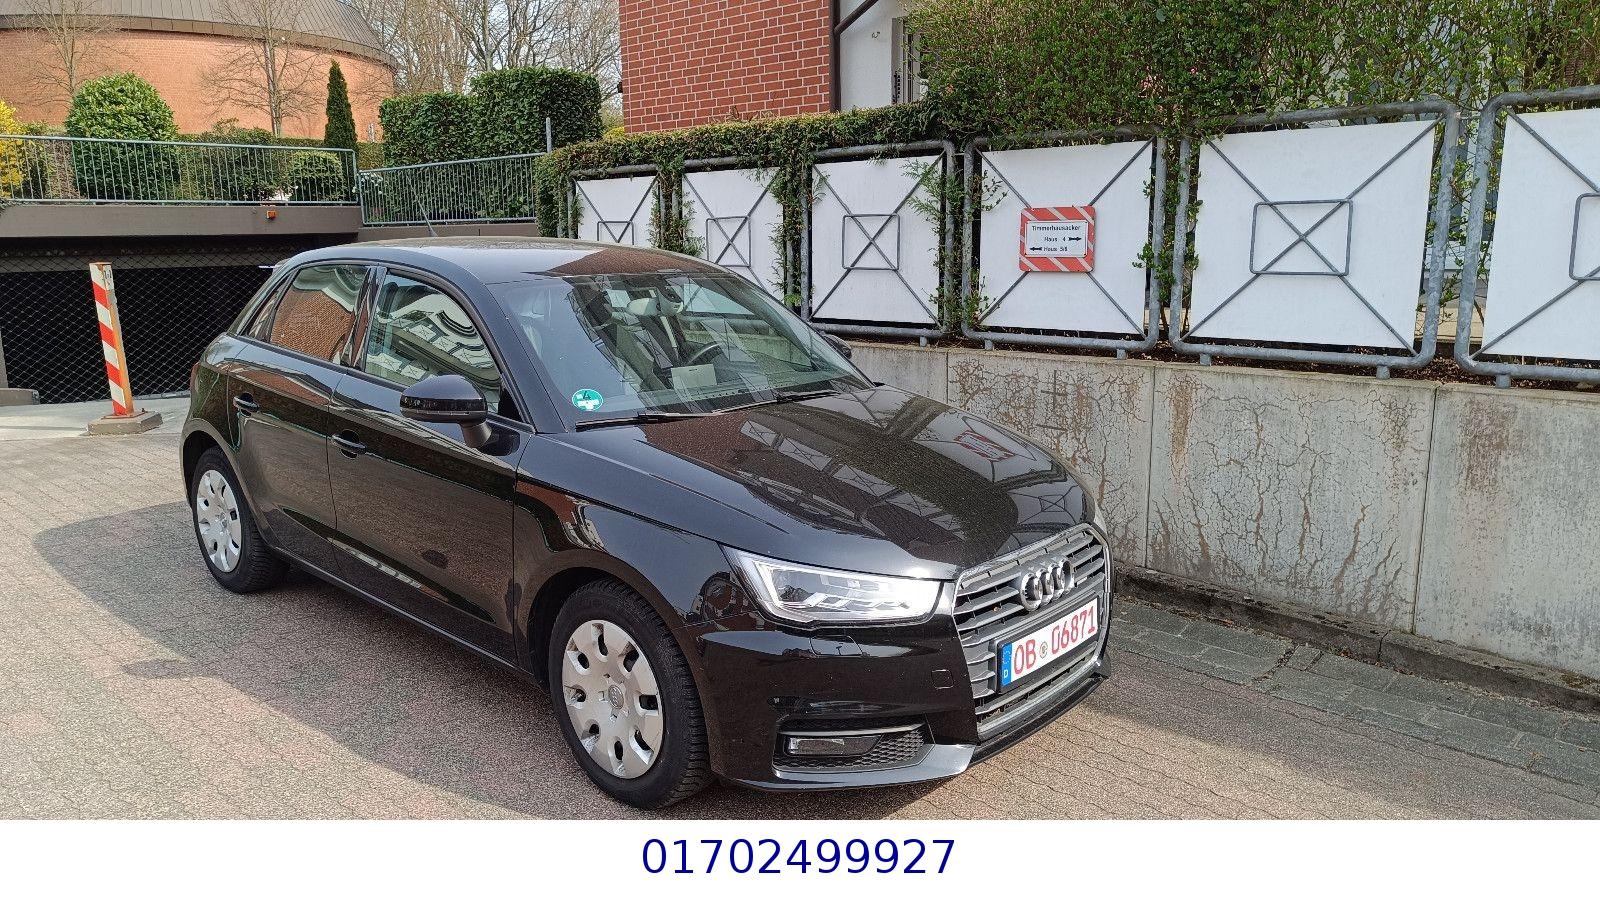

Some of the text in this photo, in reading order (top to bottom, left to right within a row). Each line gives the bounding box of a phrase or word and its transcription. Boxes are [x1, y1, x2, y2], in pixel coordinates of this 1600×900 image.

[1014, 606, 1096, 675] OB 06871
[1003, 669, 1009, 679] D
